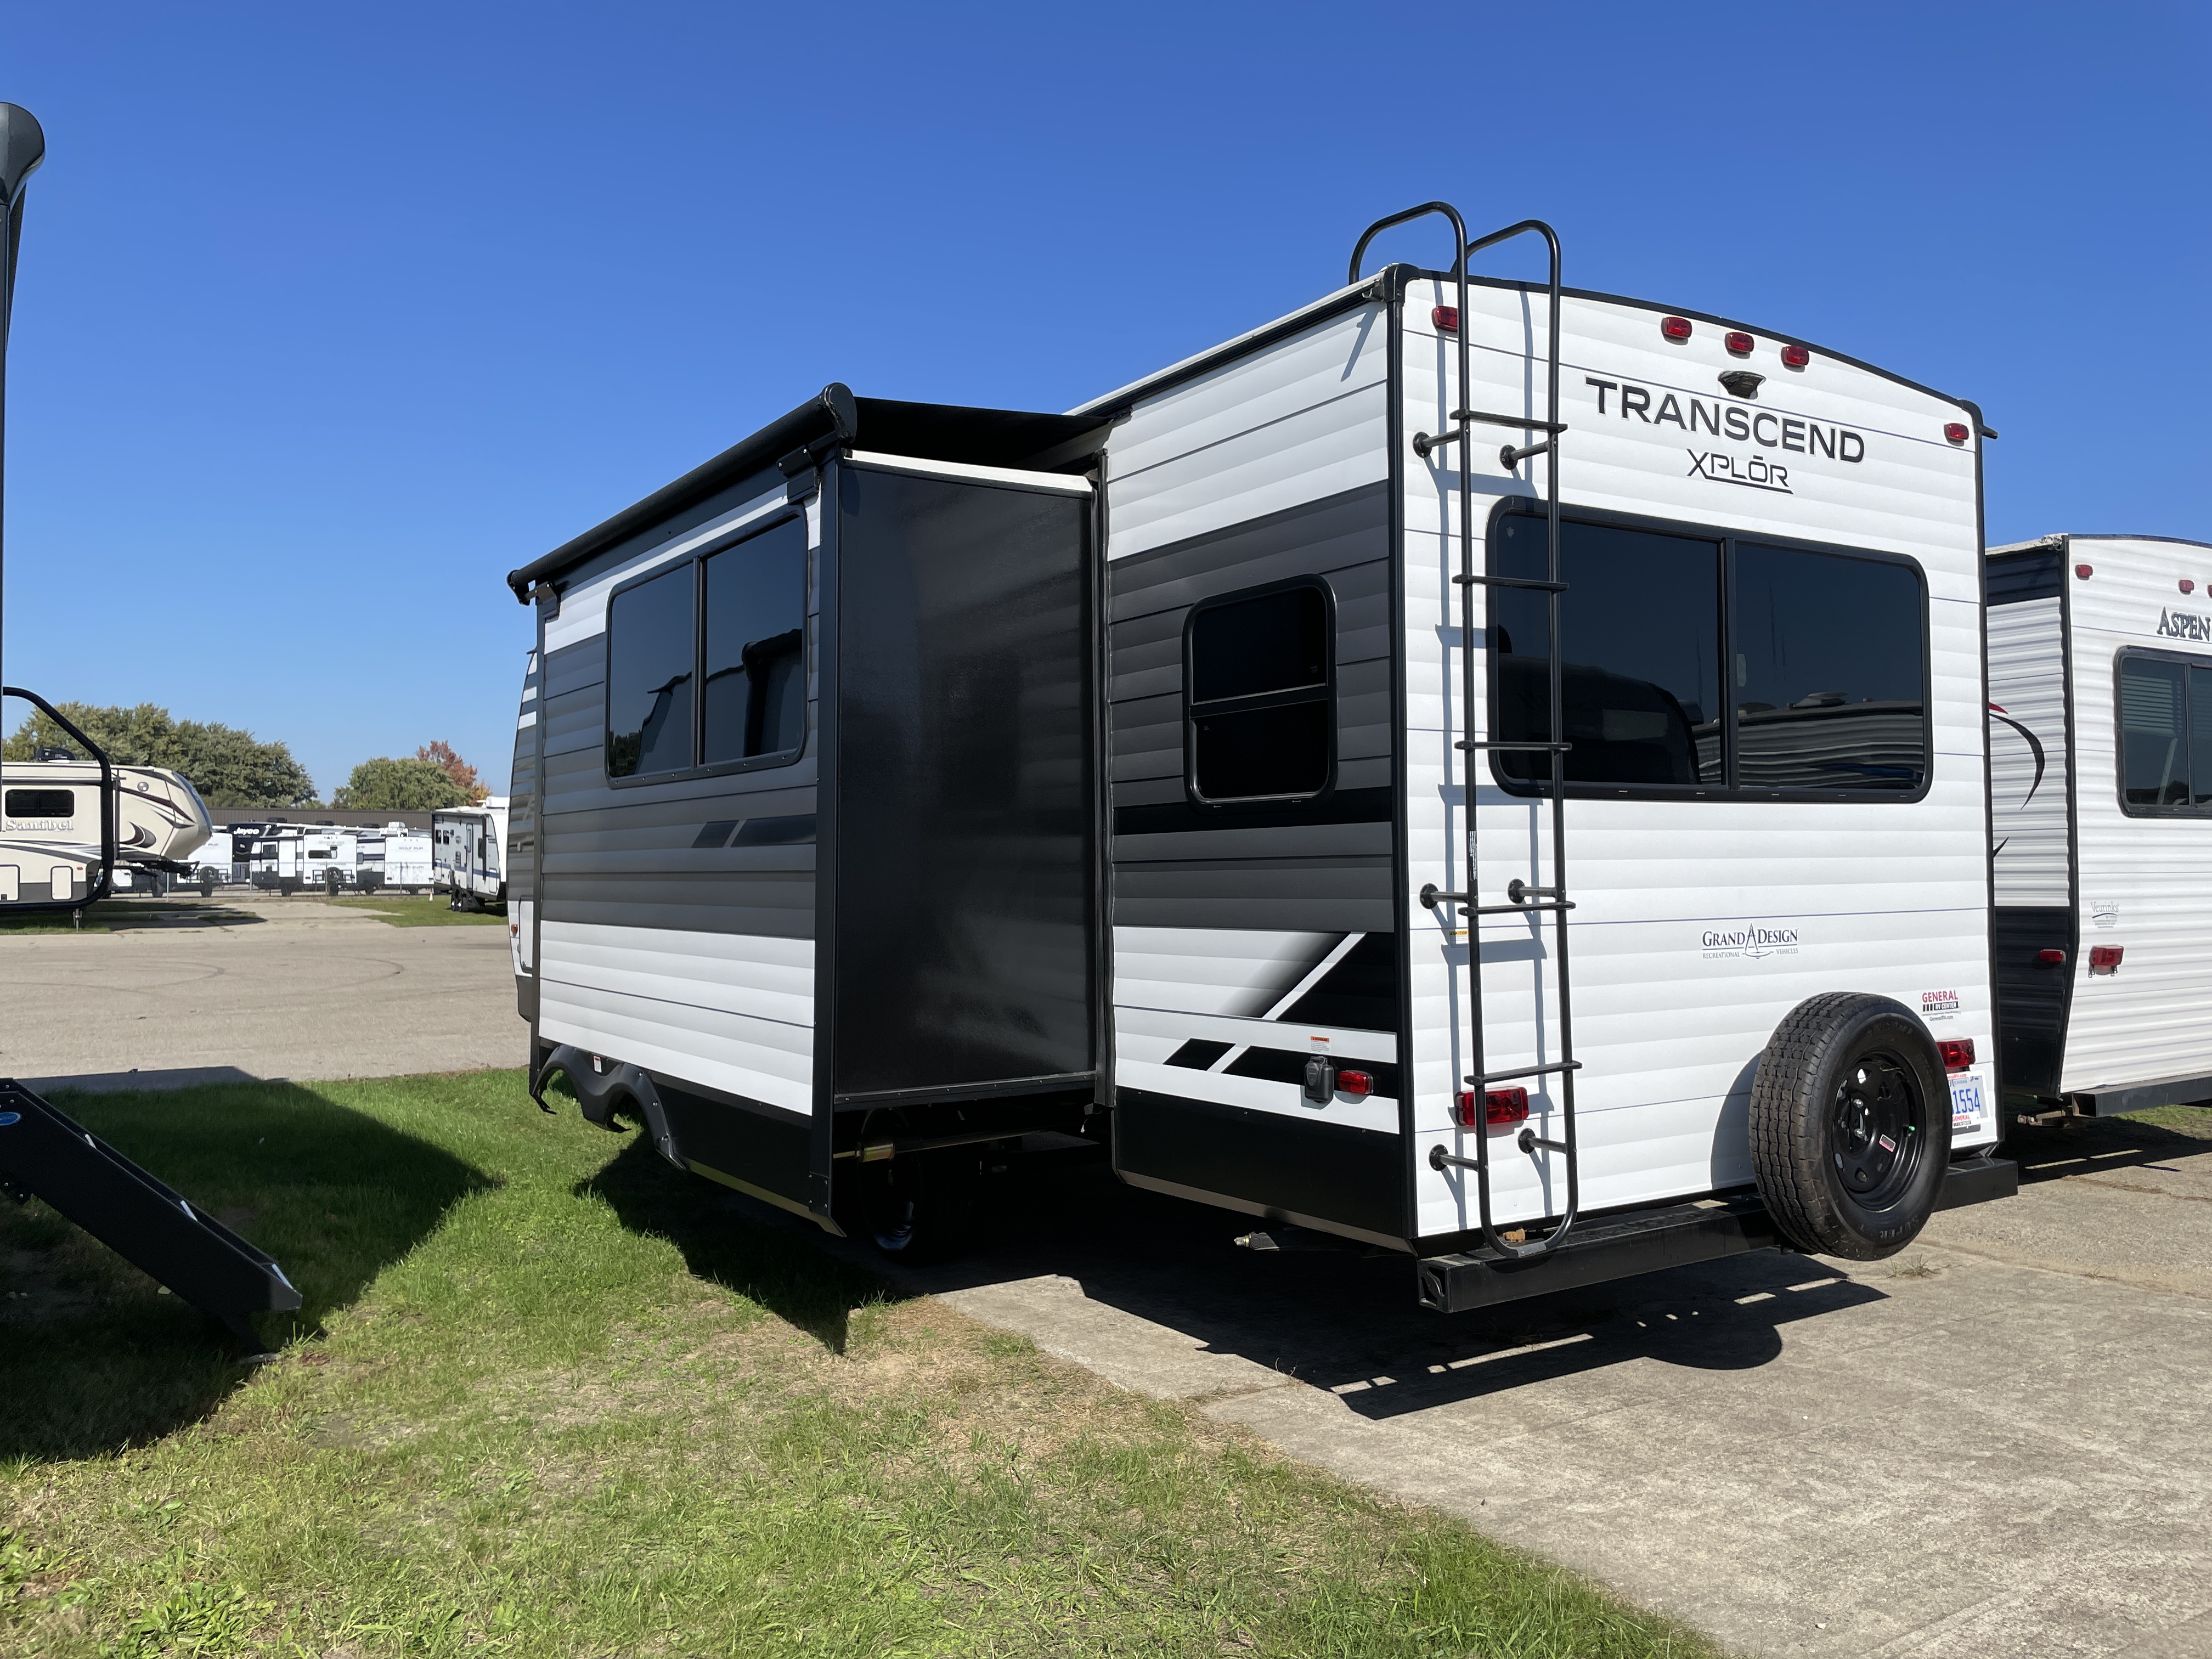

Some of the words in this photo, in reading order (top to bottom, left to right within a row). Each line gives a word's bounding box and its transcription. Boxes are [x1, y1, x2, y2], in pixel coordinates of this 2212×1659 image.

[1585, 376, 1865, 463] TRANSCEND
[2157, 606, 2211, 641] ASPEN
[5, 820, 74, 831] Sanibel
[1702, 931, 1745, 946] GRAND
[1757, 928, 1798, 944] DESIGN
[1922, 990, 1958, 1003] GENERAL
[1951, 1087, 1980, 1114] 1554
